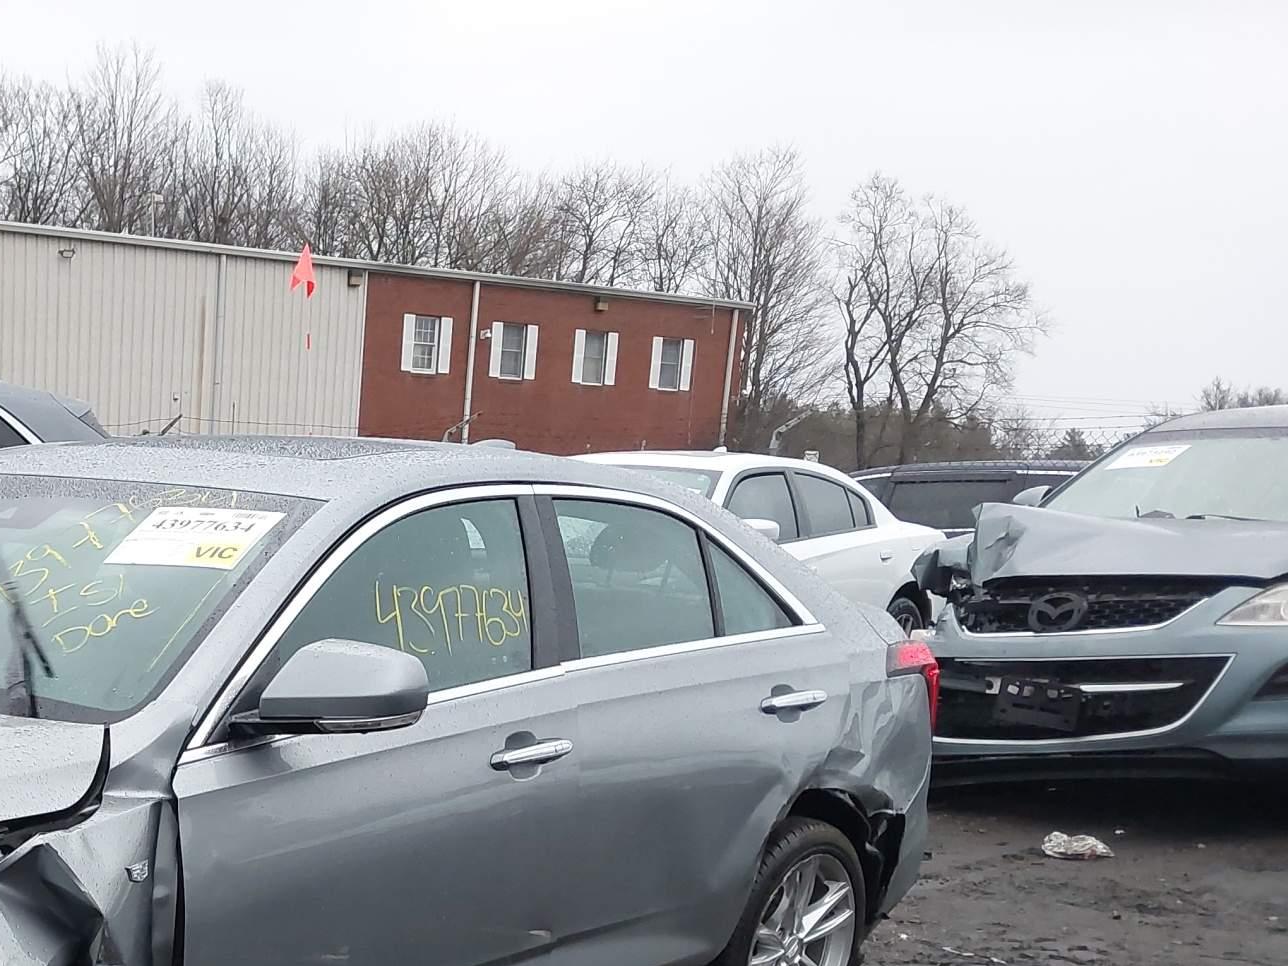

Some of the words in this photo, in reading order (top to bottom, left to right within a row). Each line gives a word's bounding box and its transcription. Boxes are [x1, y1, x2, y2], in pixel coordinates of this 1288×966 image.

[152, 519, 256, 533] 43977634
[195, 546, 238, 559] VIC
[50, 598, 161, 656] Done
[375, 580, 529, 657] 43977634
